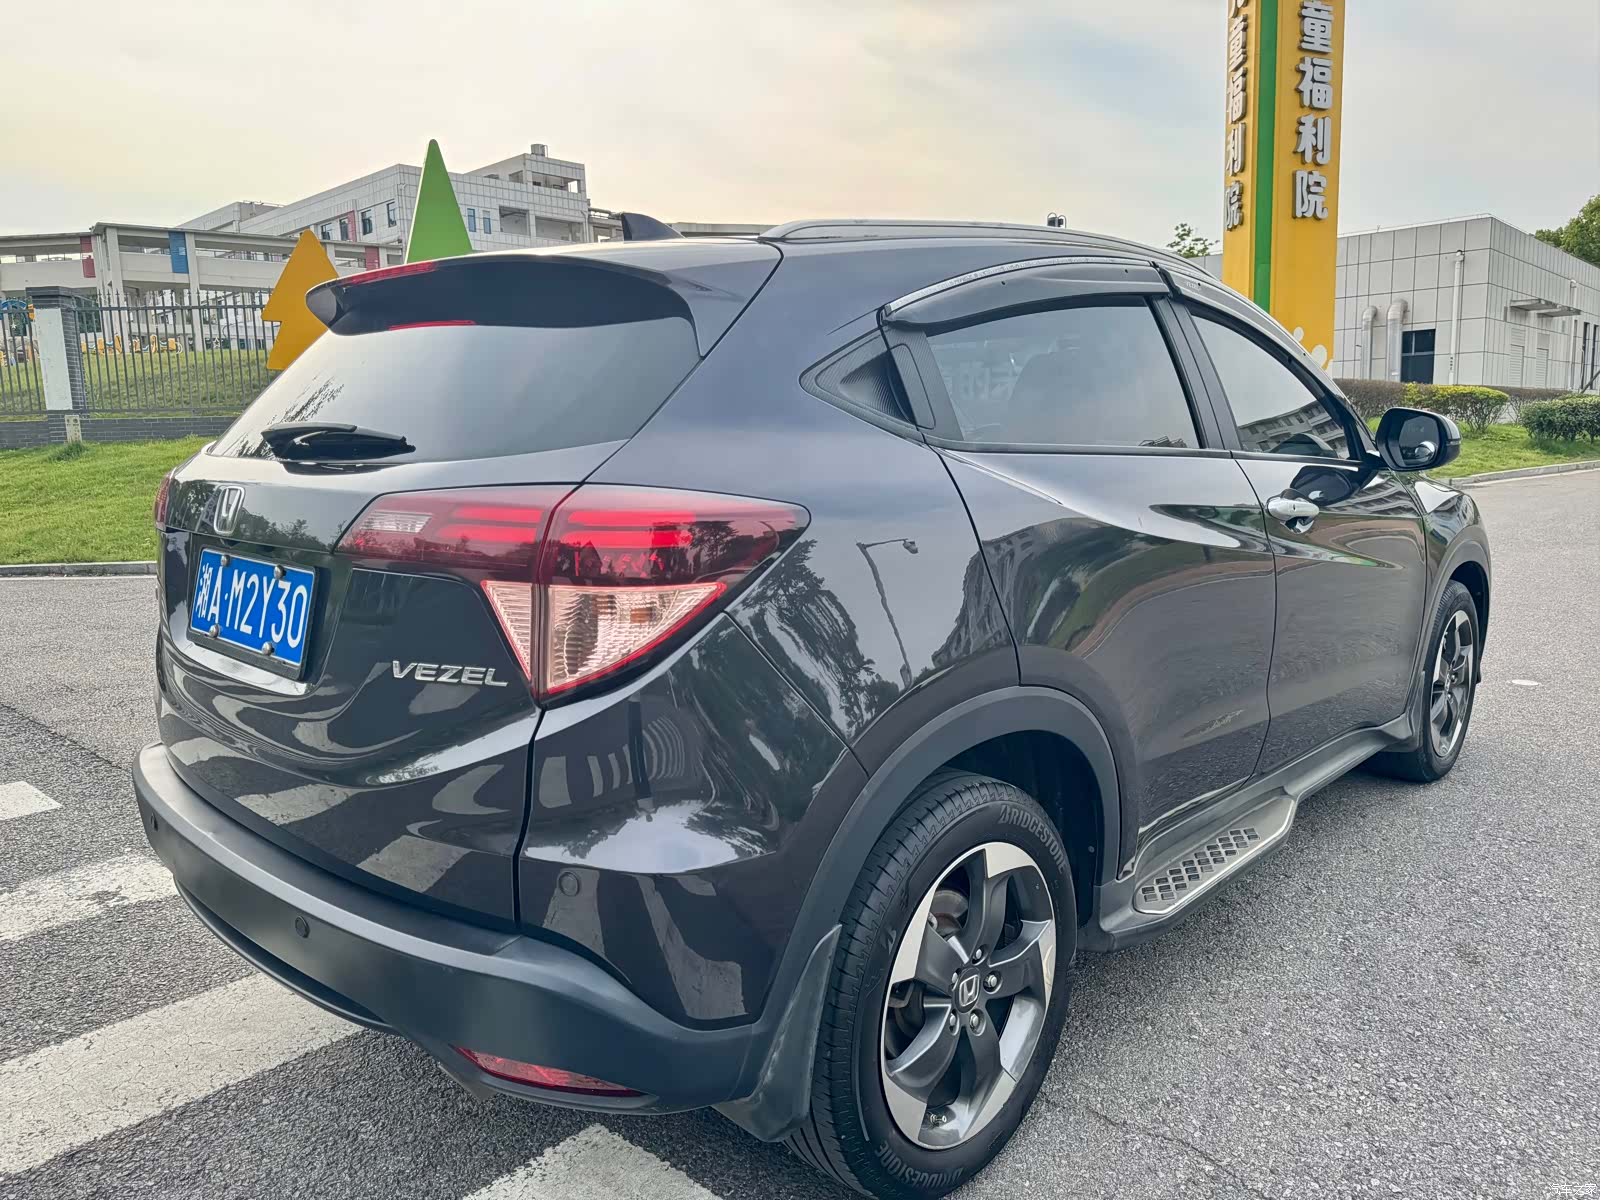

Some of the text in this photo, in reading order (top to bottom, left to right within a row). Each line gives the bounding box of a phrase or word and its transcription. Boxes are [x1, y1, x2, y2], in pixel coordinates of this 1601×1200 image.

[1295, 0, 1333, 218] 童福利院
[392, 660, 508, 687] VEZEL
[998, 804, 1067, 874] BRIDGESTONE
